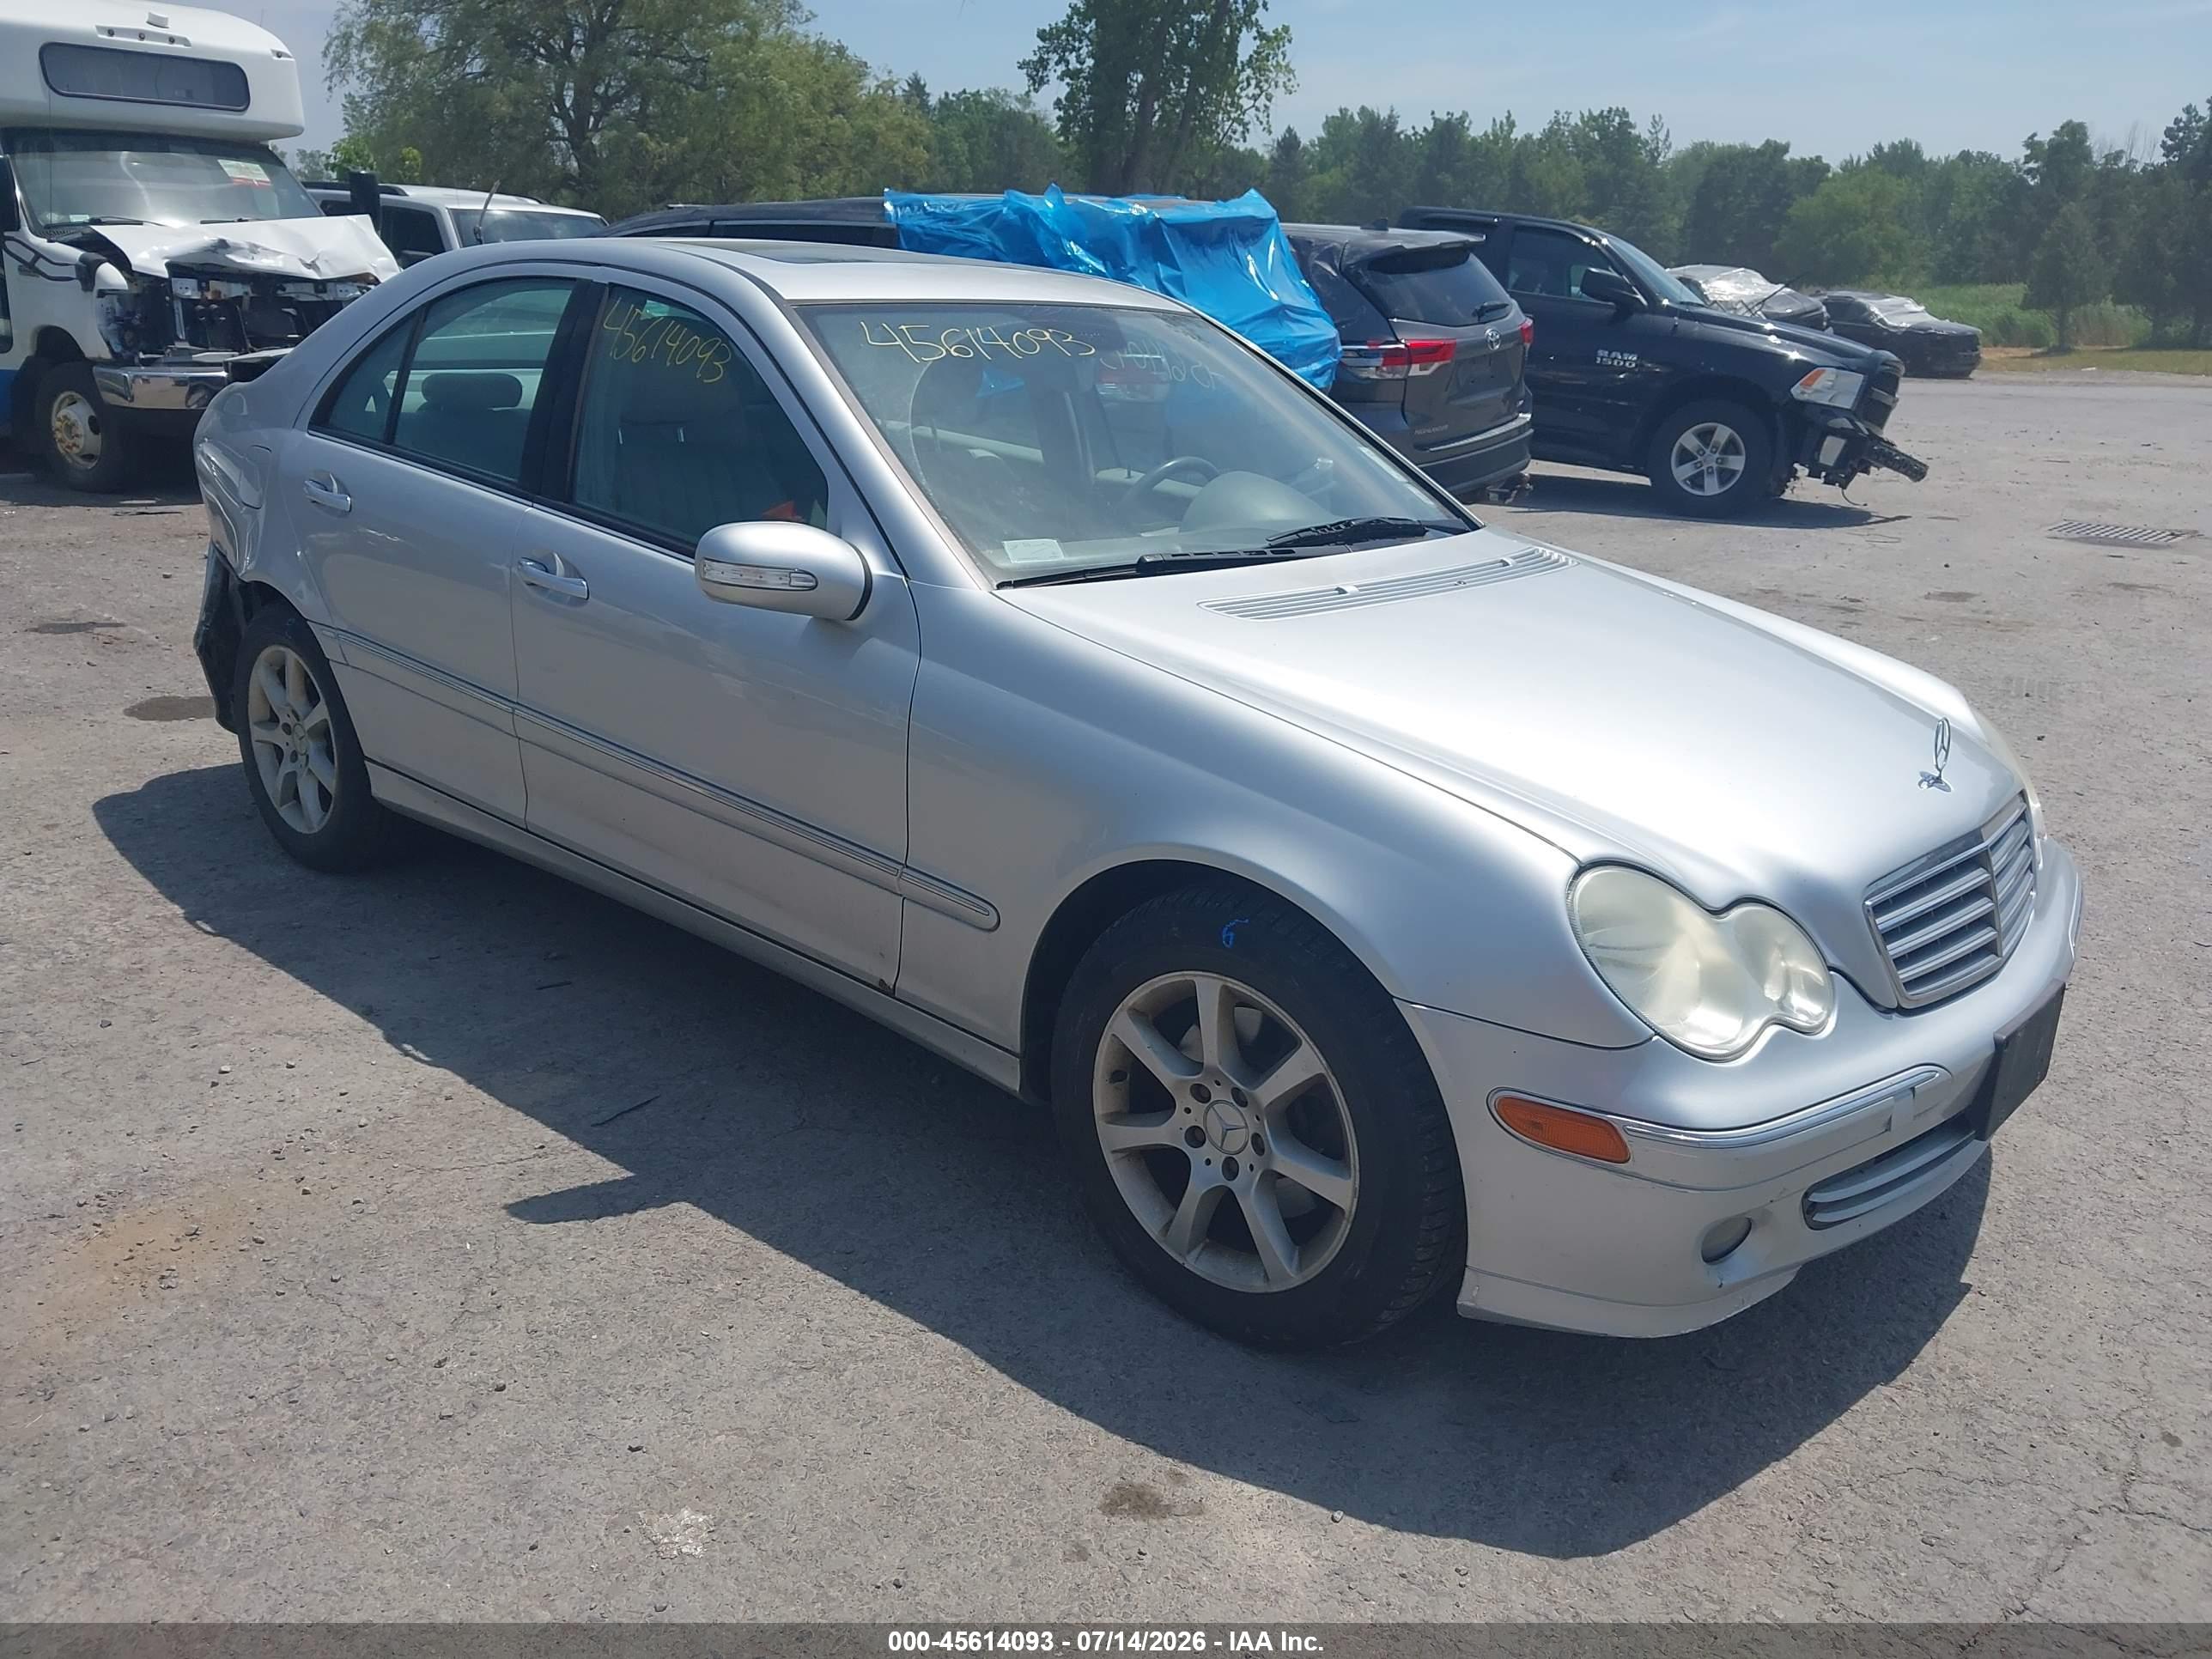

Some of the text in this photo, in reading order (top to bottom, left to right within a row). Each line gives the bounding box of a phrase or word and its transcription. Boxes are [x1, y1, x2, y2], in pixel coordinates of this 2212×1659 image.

[604, 297, 732, 383] 45614093
[861, 321, 1097, 363] 45614093
[1596, 349, 1638, 361] RAM
[1596, 356, 1636, 368] 1500
